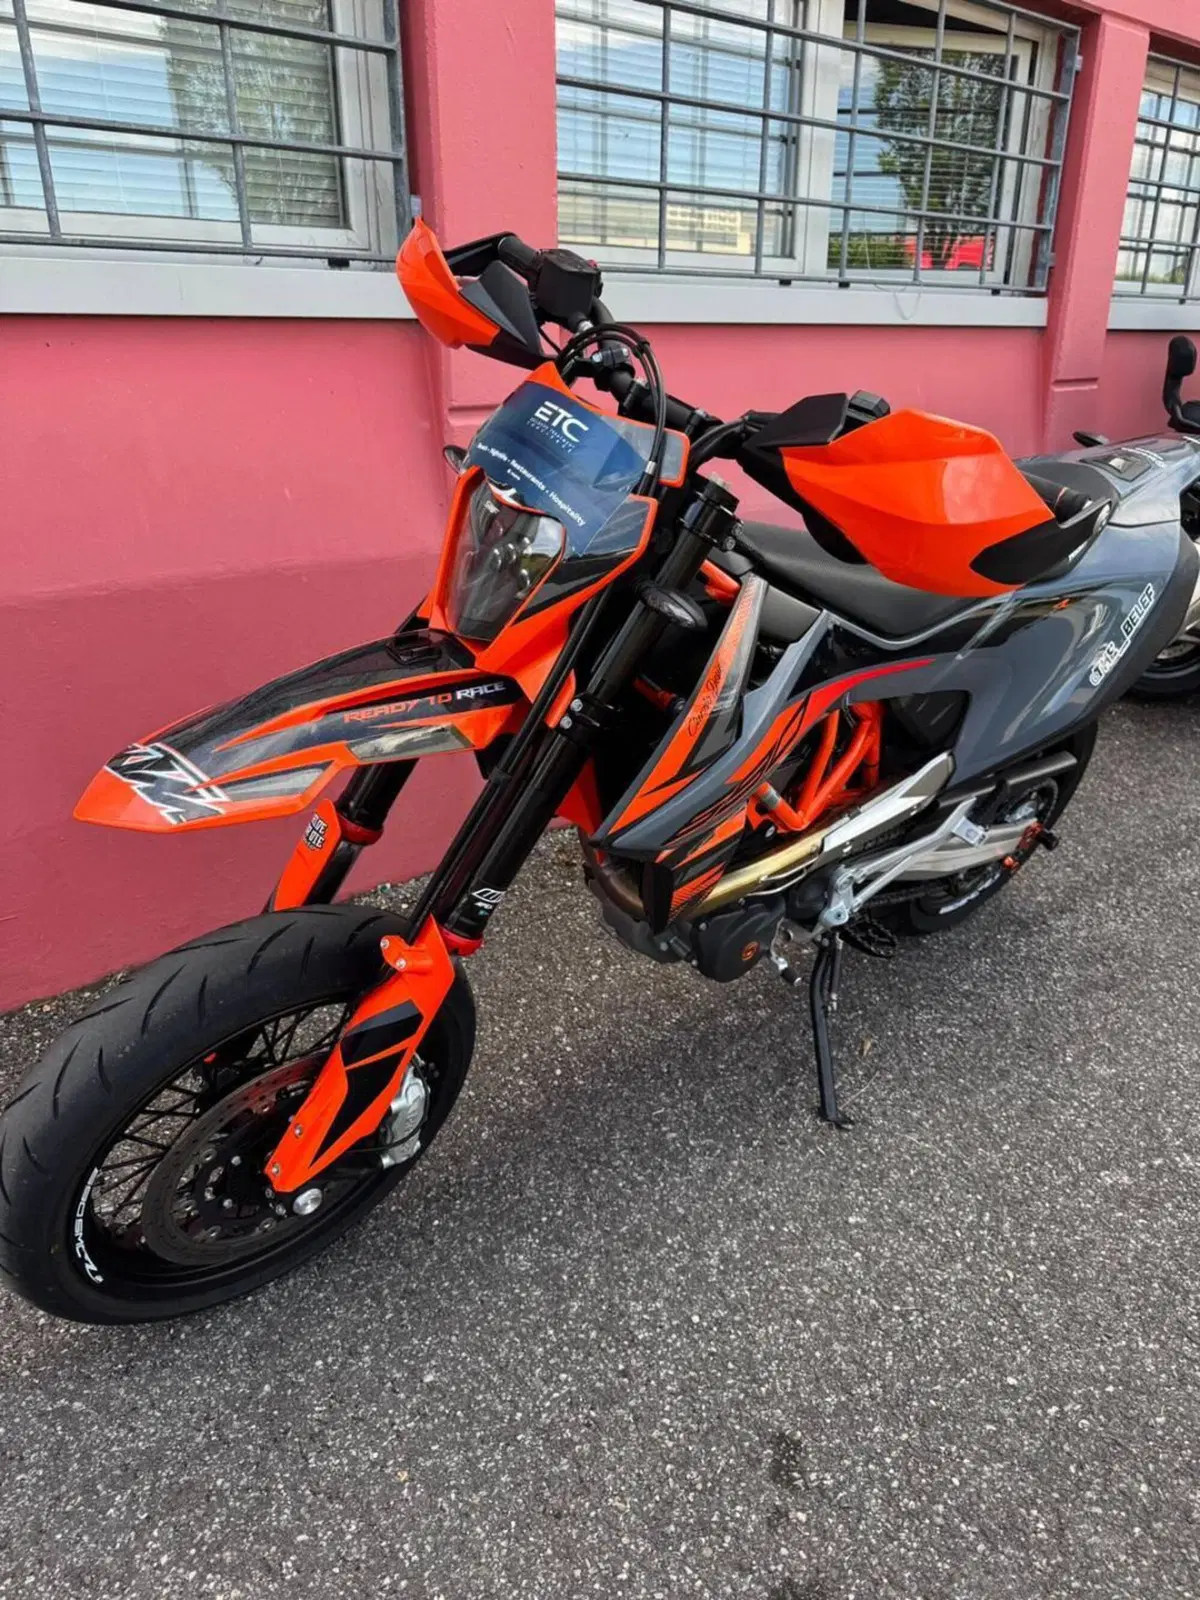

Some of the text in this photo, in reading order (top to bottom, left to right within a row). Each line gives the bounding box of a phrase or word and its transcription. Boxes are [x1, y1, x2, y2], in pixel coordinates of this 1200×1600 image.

[533, 400, 589, 443] ETC
[549, 491, 586, 527] Hospitality
[343, 681, 507, 723] READY TO RACE
